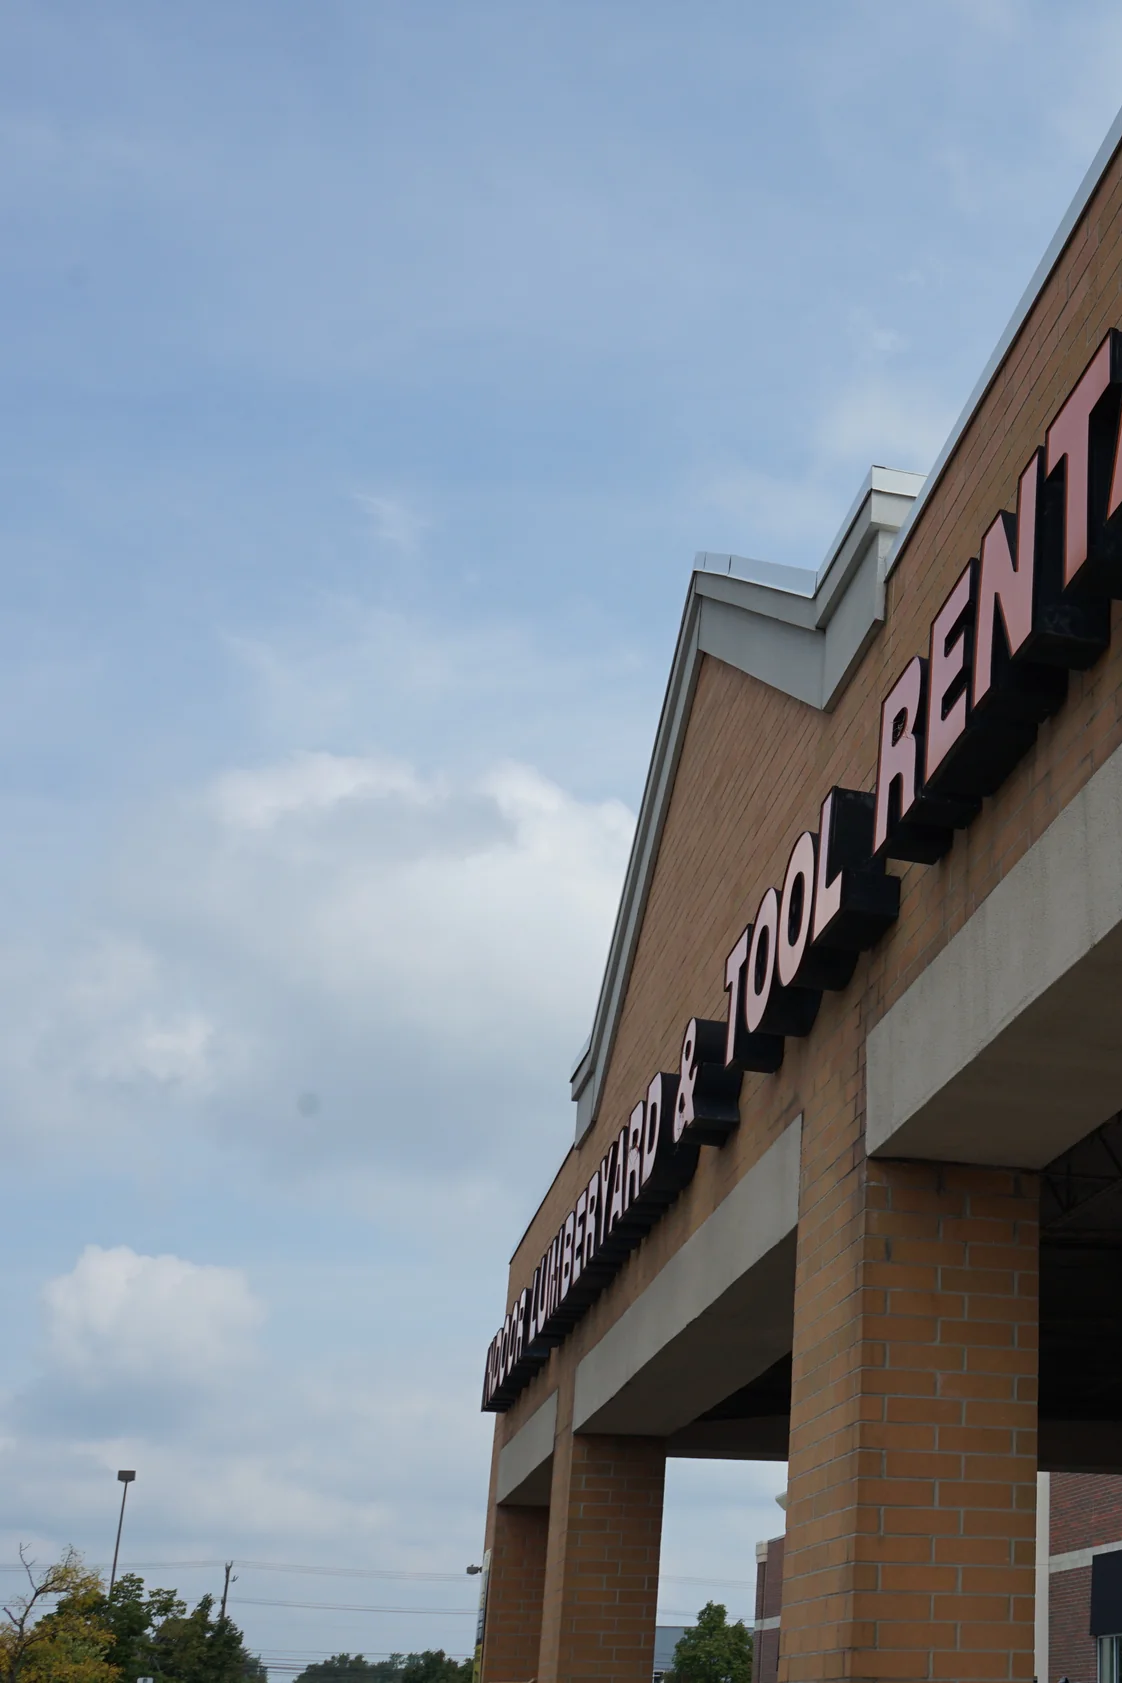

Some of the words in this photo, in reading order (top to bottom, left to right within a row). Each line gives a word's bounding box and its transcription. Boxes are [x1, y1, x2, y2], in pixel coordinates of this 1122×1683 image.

[528, 1072, 664, 1344] LUMBERYARD
[673, 1017, 699, 1144] &
[725, 786, 842, 1070] TOOL
